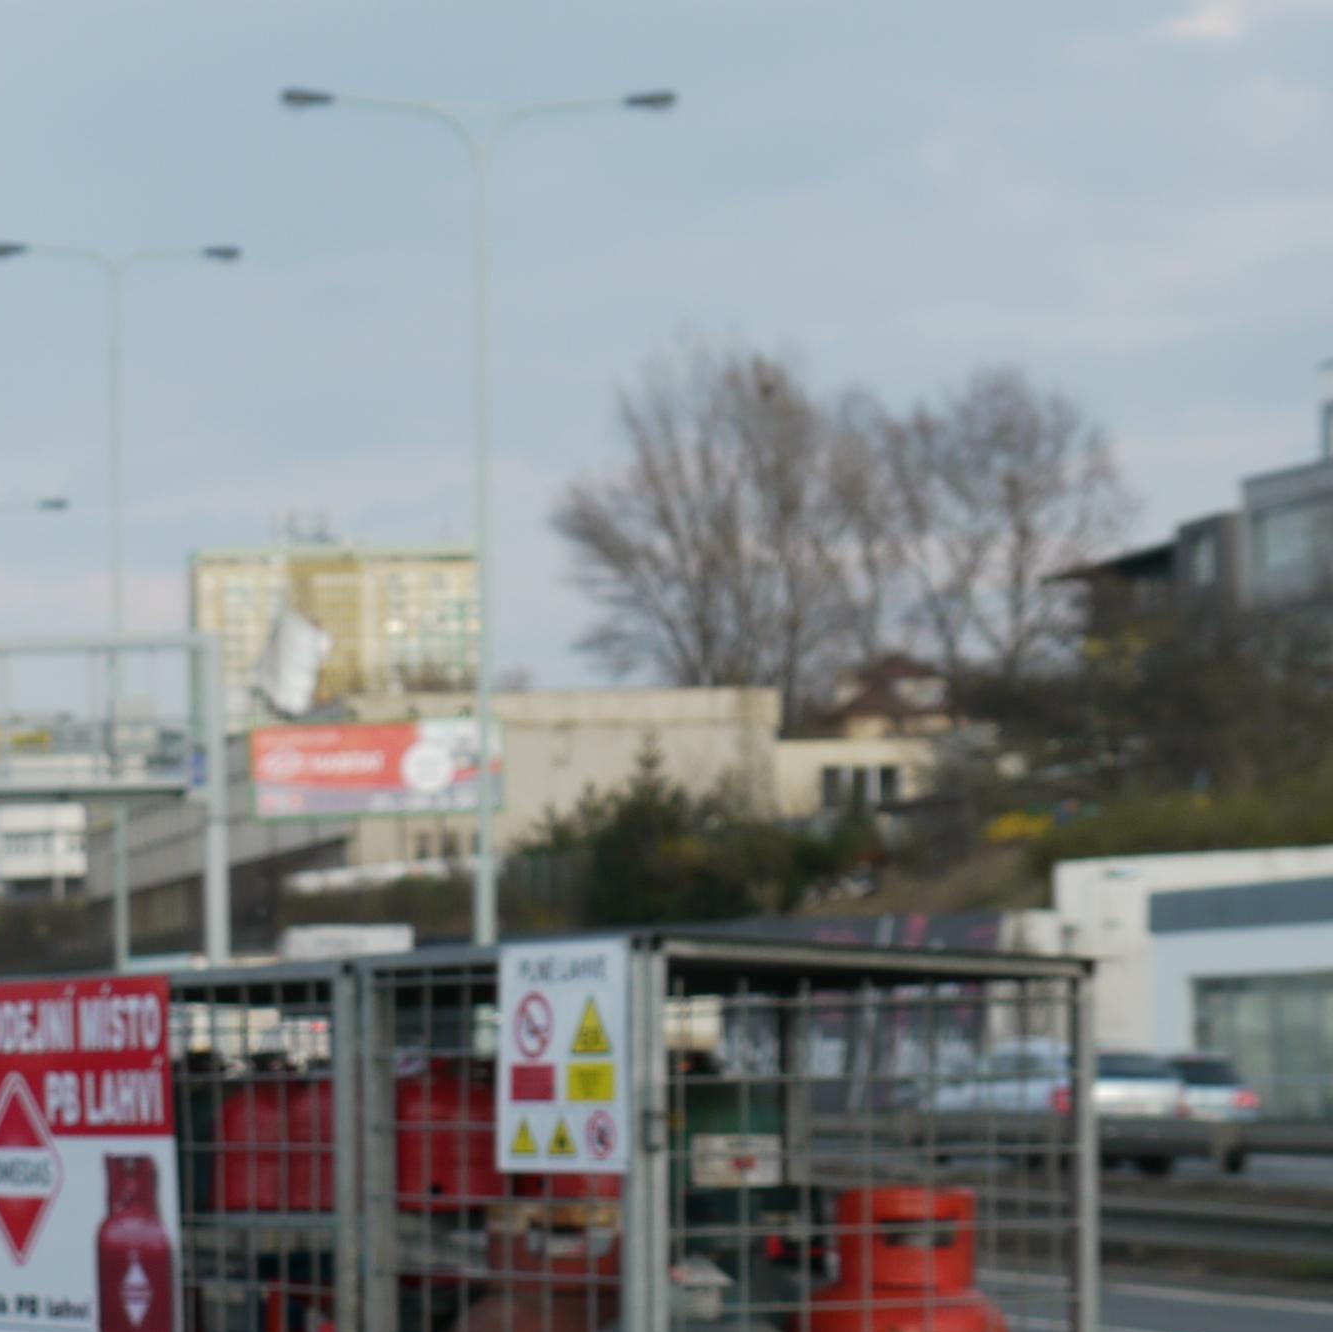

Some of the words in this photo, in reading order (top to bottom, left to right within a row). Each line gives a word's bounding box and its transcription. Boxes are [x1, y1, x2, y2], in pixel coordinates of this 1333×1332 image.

[78, 983, 162, 1053] MÍSTO
[44, 1069, 82, 1127] PB
[84, 1054, 165, 1126] LAHVÍ
